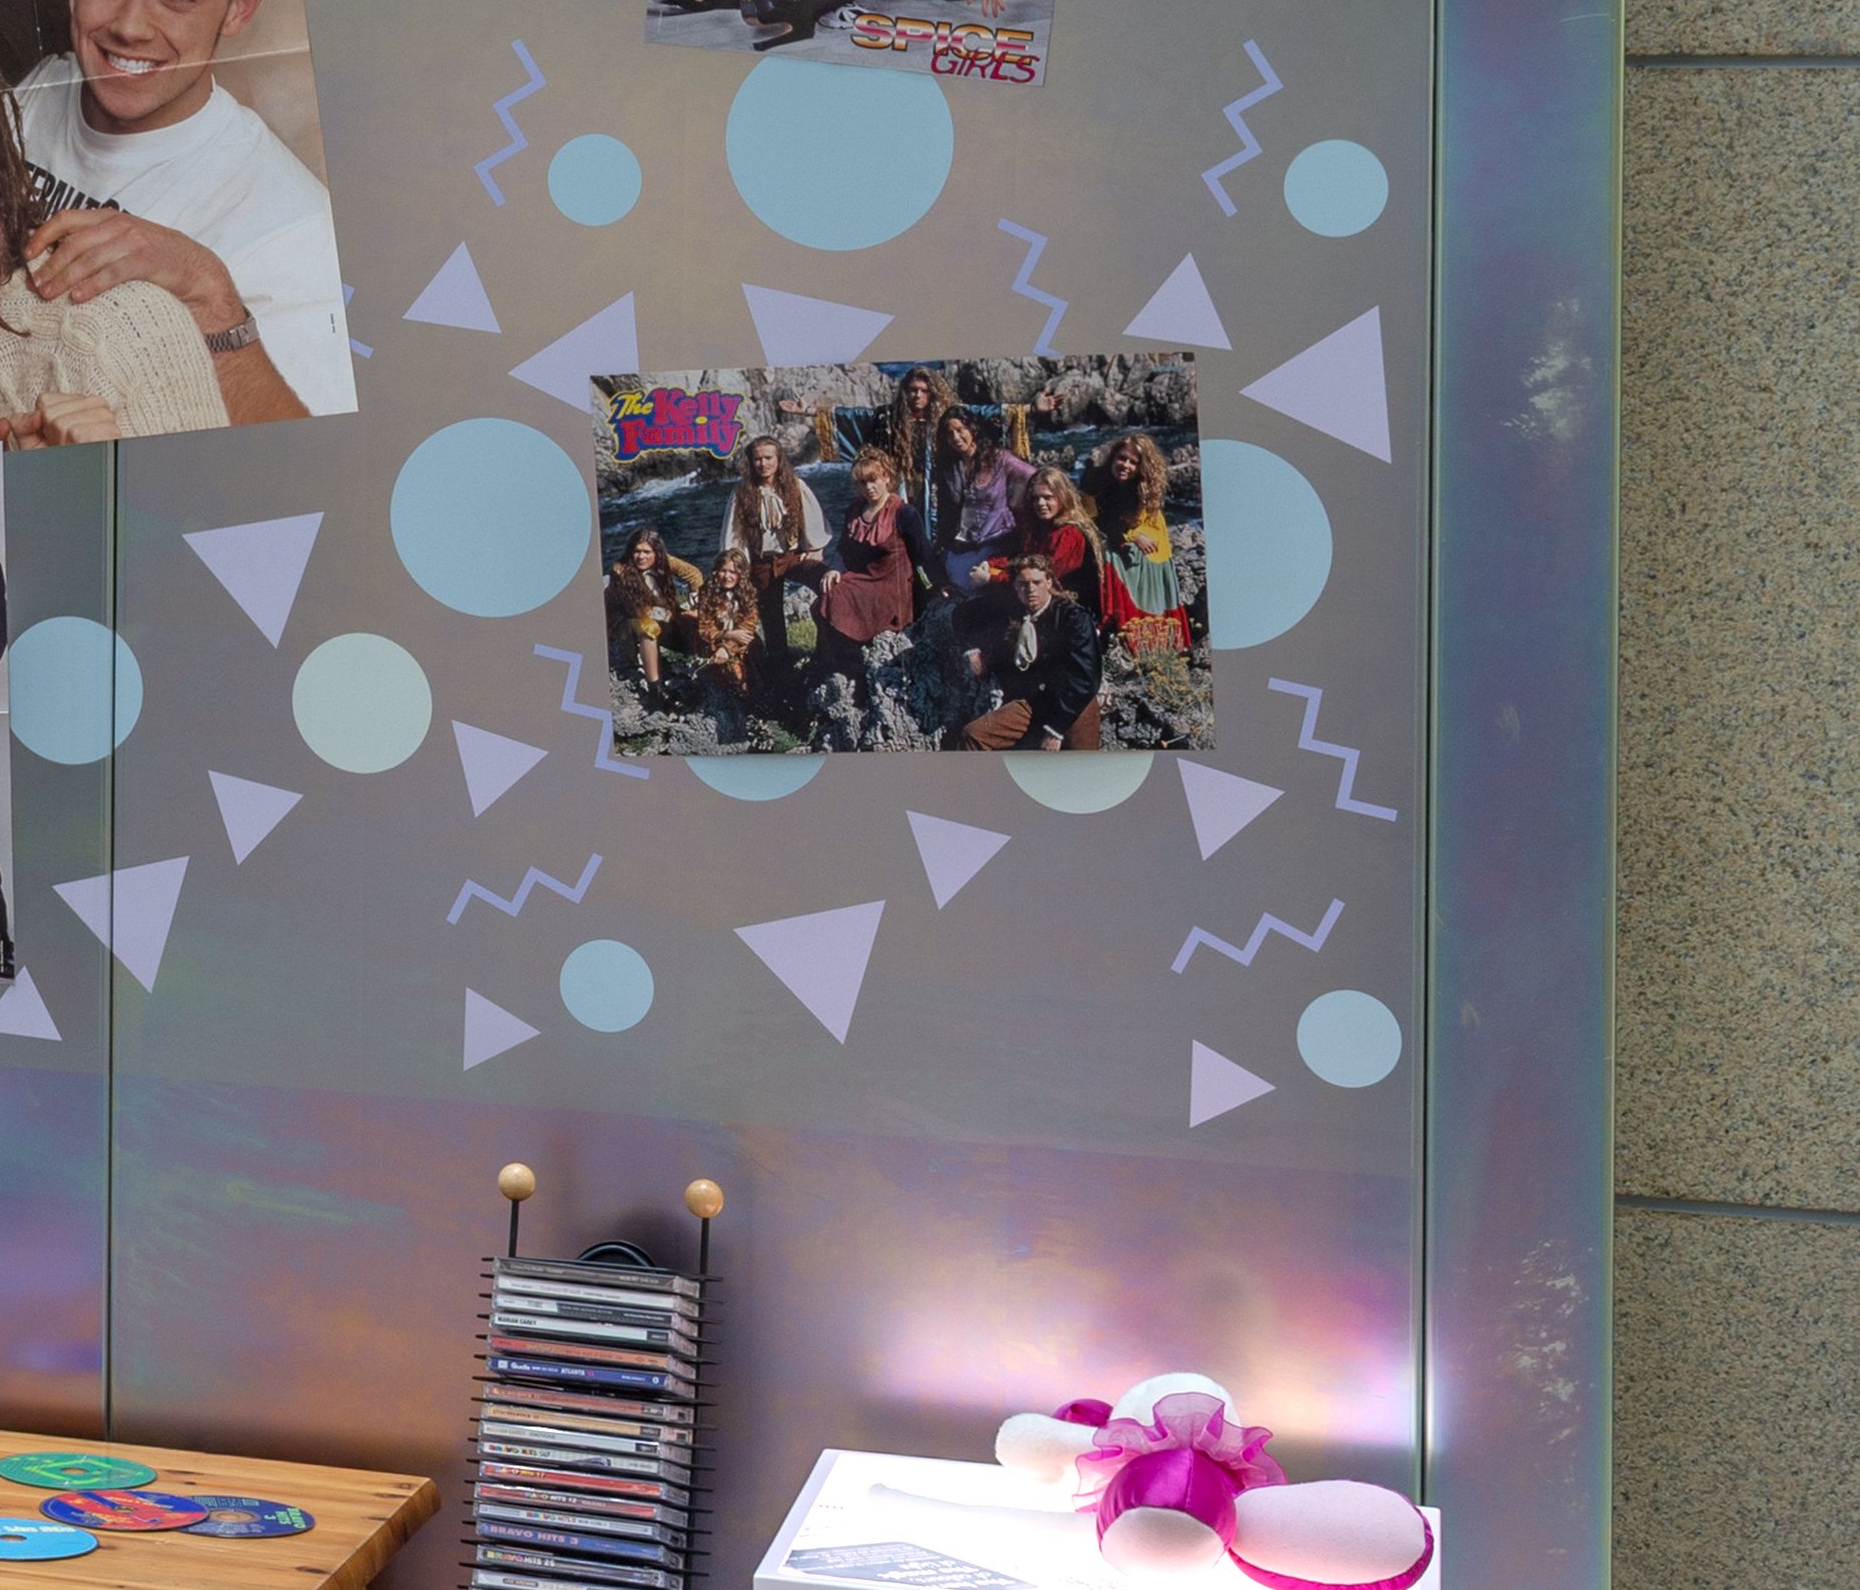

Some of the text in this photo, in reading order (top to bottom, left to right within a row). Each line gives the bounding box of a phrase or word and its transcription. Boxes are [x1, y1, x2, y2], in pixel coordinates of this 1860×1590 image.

[849, 13, 1034, 66] SPICE
[930, 48, 1041, 84] GIRLS
[616, 388, 743, 425] The Kelly
[621, 417, 741, 454] Family
[490, 1525, 579, 1545] BRAVO HITS 3
